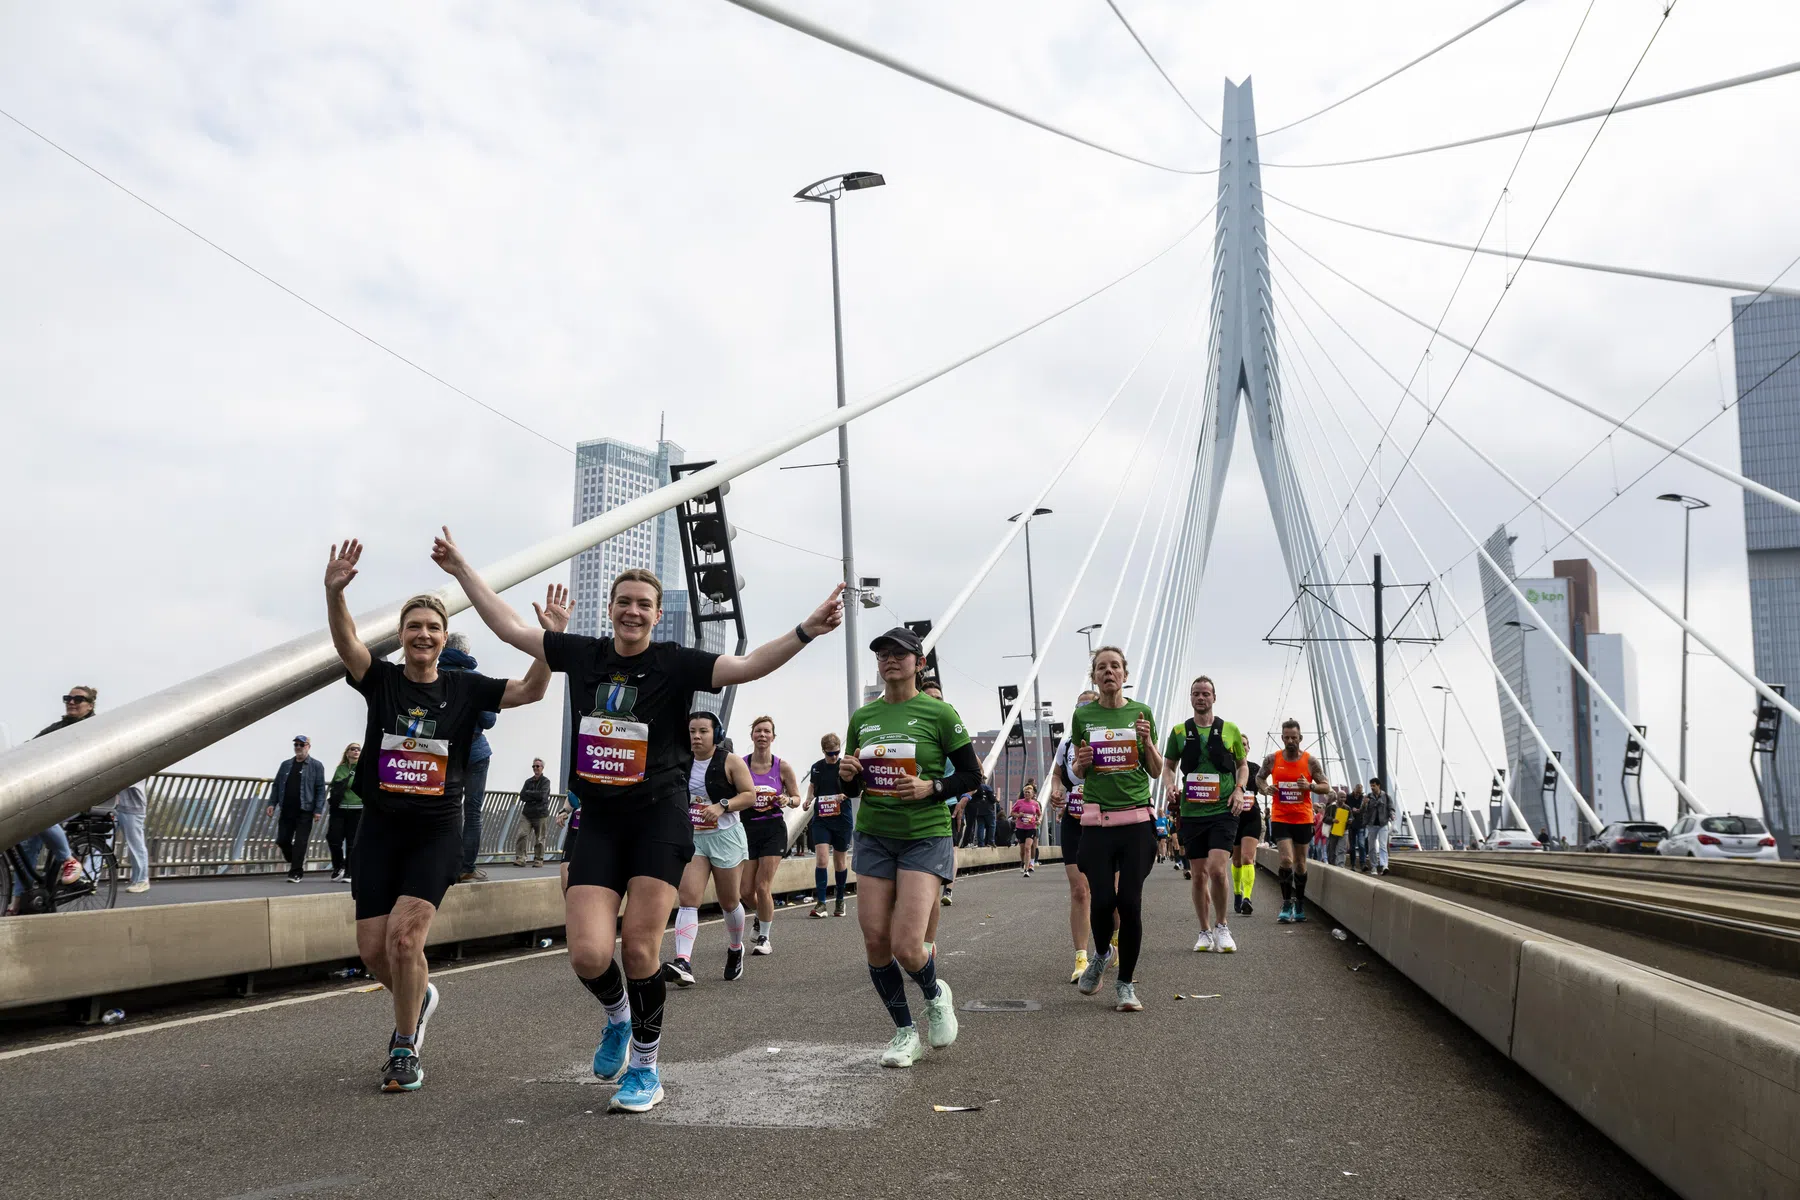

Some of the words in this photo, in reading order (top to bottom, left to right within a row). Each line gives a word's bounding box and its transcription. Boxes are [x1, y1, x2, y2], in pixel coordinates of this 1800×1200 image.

[1541, 591, 1564, 603] kpn
[586, 744, 636, 760] SOPHIE
[1096, 746, 1132, 754] MIRIAM
[387, 758, 438, 771] AGNITA
[592, 760, 624, 772] 21011
[868, 766, 906, 774] CECILIA
[396, 771, 428, 782] 21013
[874, 777, 897, 786] 1814
